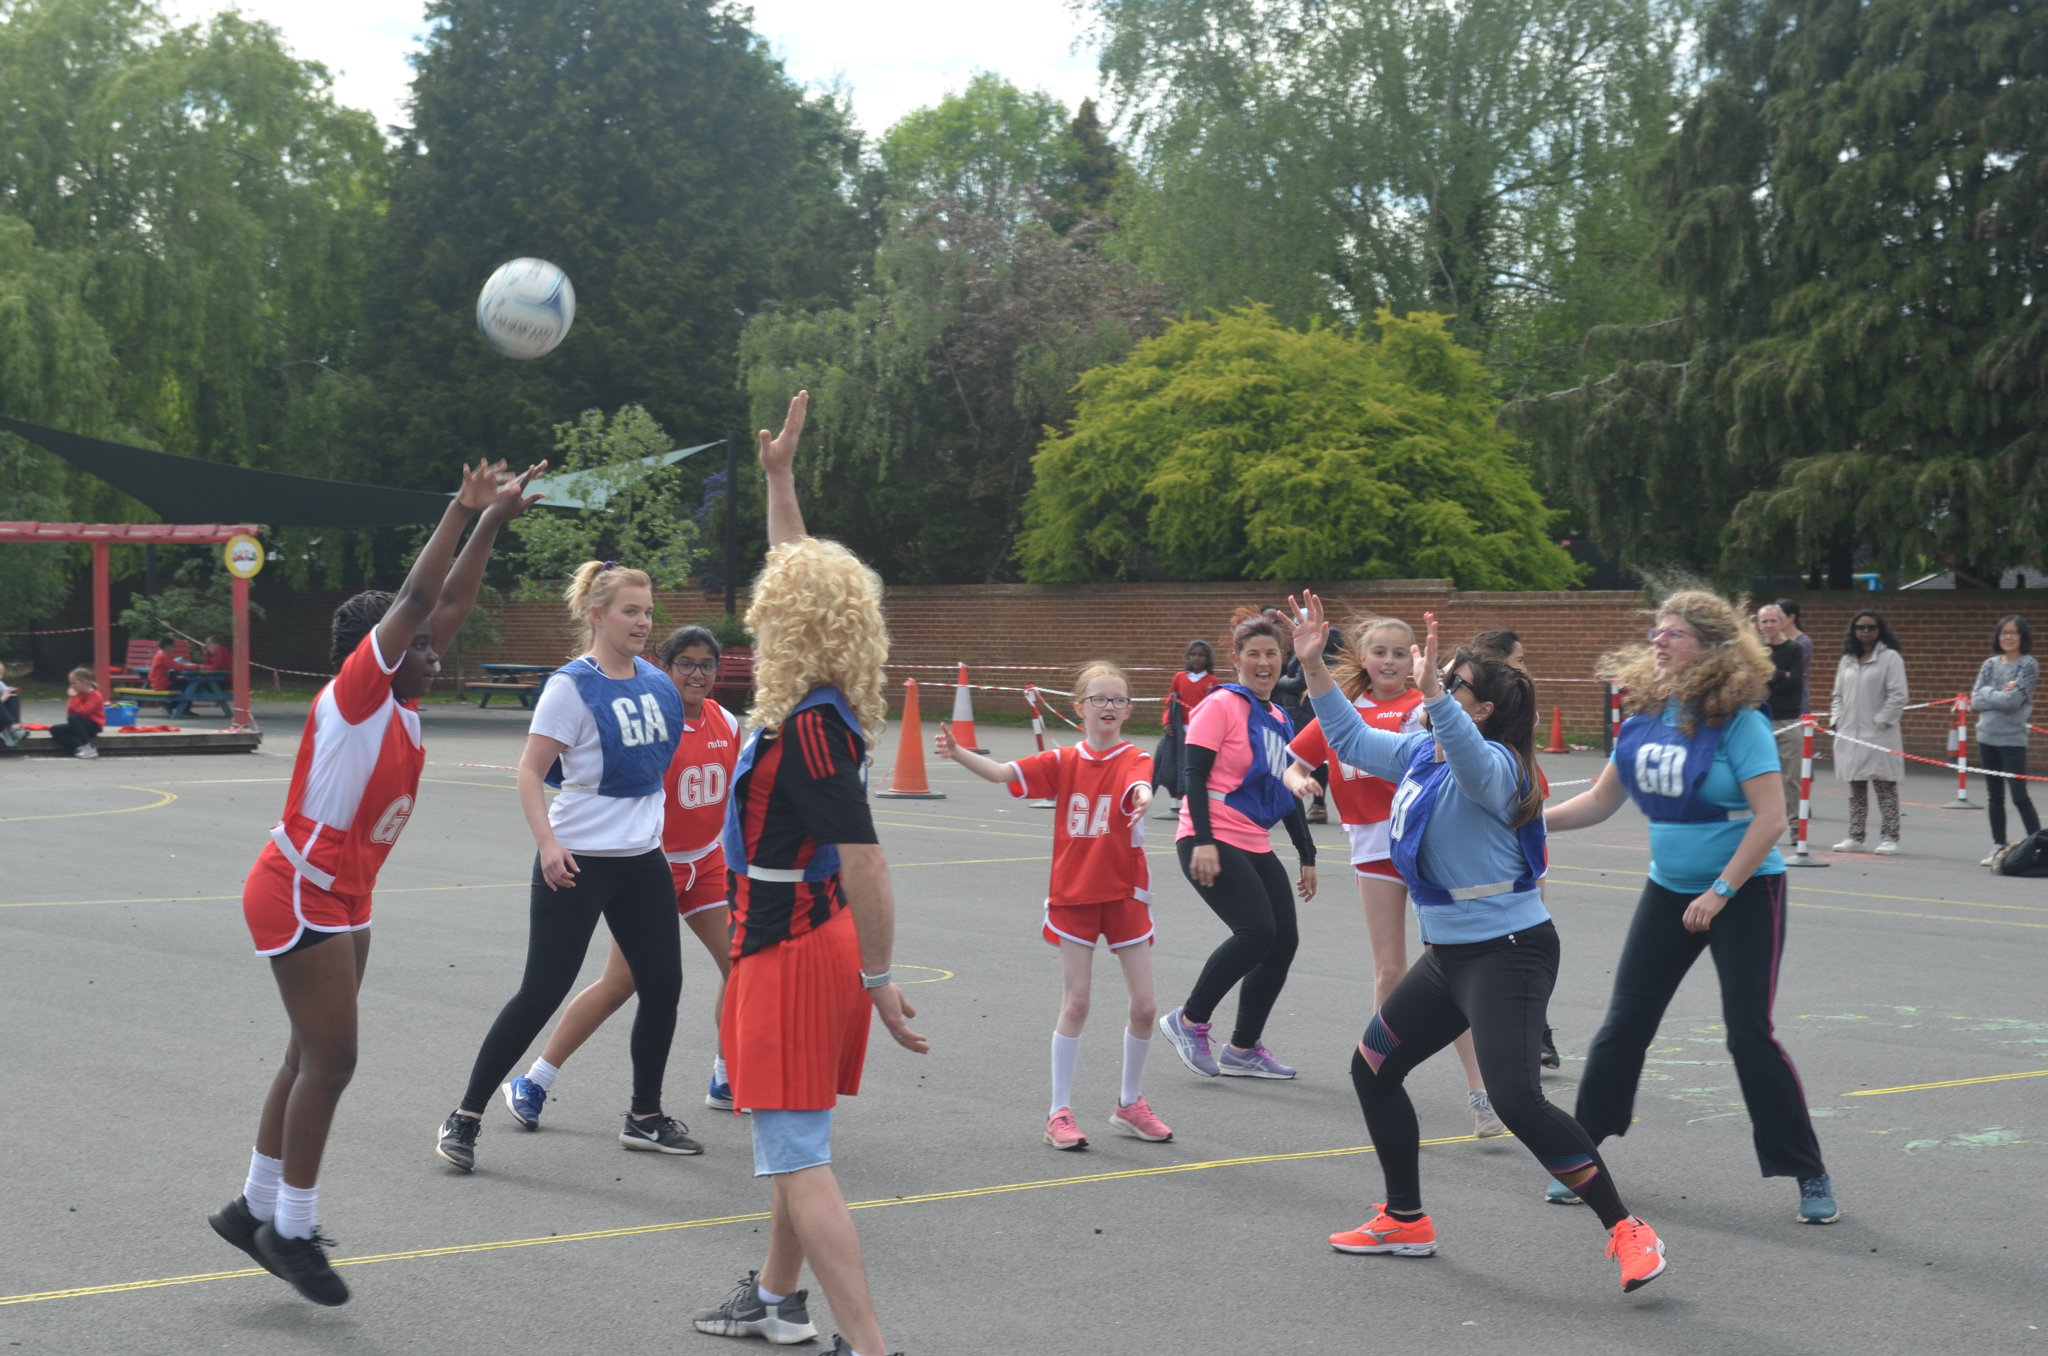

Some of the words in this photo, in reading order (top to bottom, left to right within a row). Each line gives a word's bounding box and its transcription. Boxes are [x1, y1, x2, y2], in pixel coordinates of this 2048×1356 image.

[611, 693, 669, 748] GA
[1376, 711, 1403, 719] mitre
[707, 739, 728, 749] mitre
[678, 762, 727, 809] GD
[1635, 742, 1687, 798] GD
[1067, 792, 1112, 838] GA
